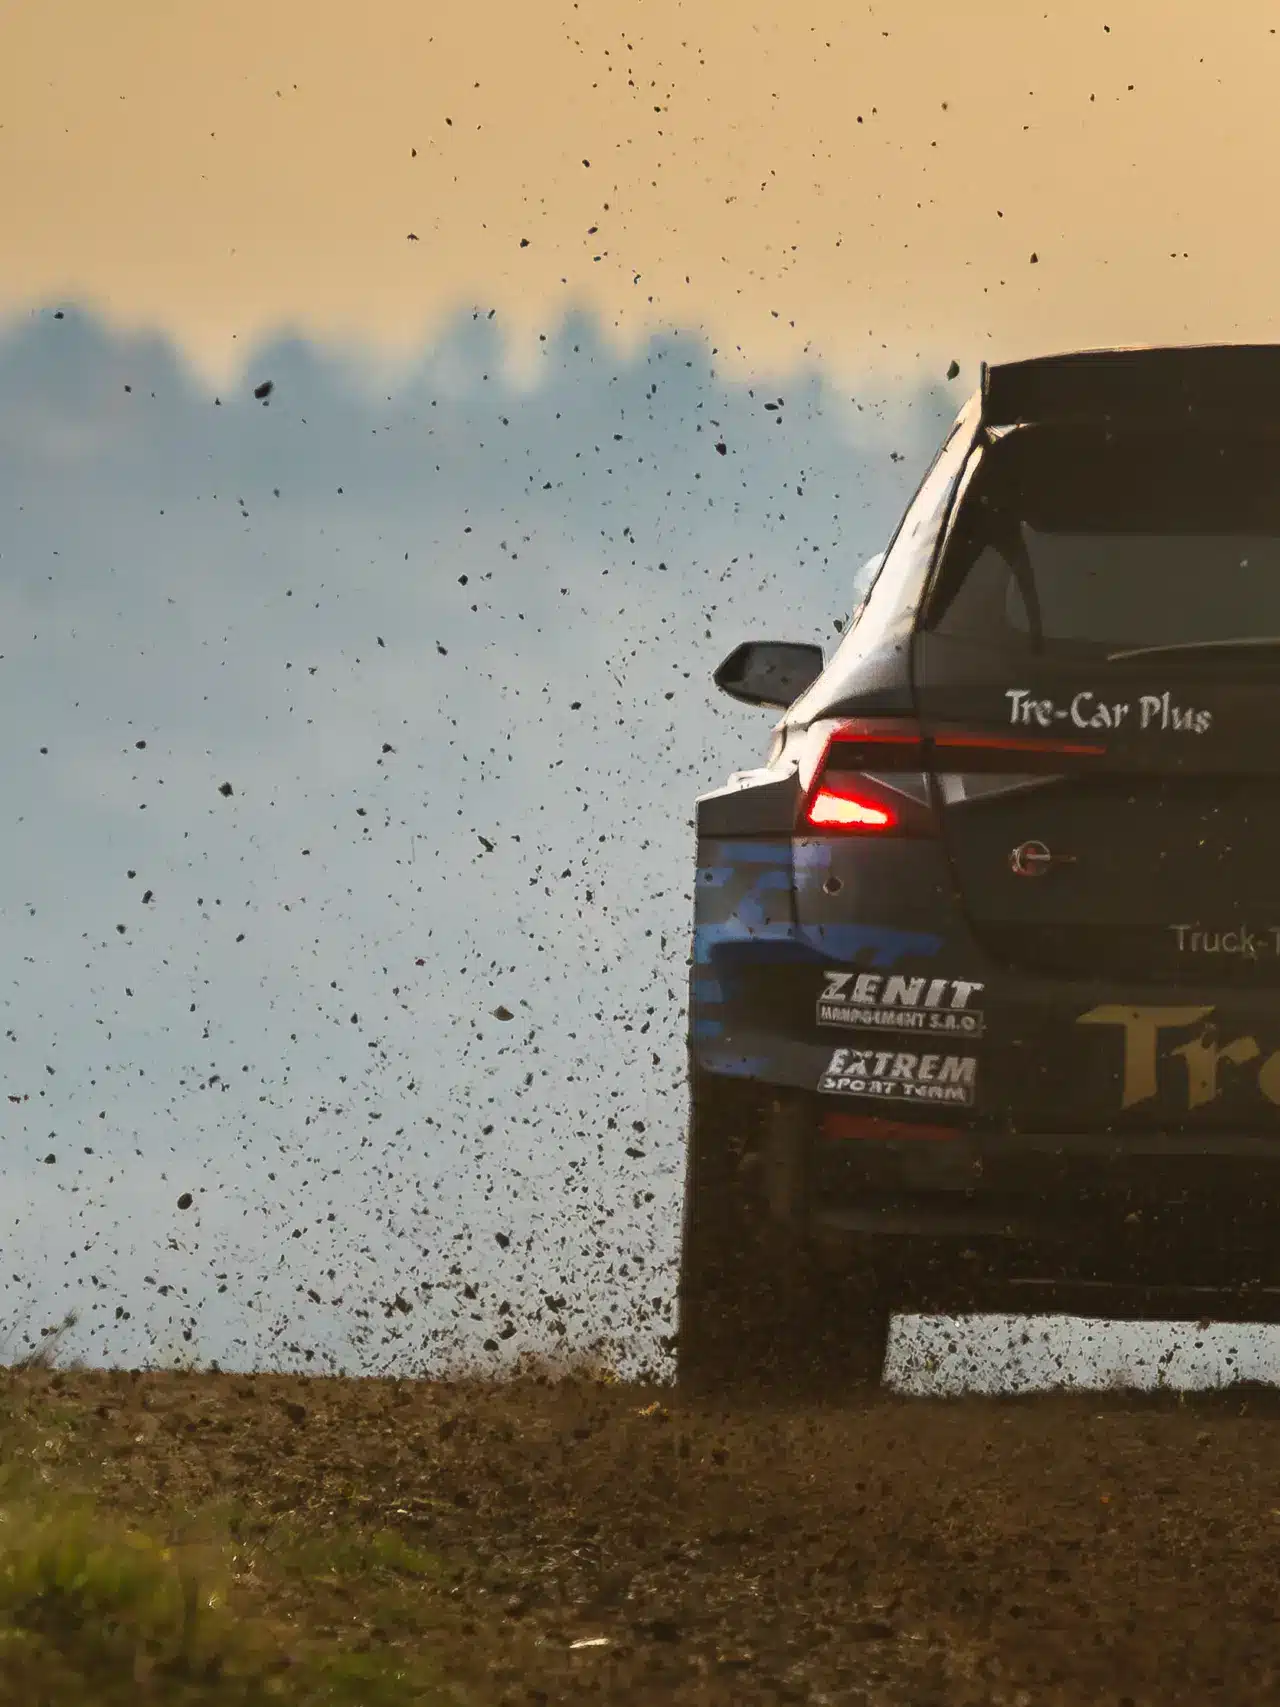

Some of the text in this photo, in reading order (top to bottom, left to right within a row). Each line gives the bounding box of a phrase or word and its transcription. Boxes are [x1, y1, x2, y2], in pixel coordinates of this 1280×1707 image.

[1004, 688, 1213, 735] Tre-Car Plus
[820, 970, 985, 1009] ZENIT
[826, 1048, 977, 1084] EXTREM
[822, 1077, 897, 1095] SPORT
